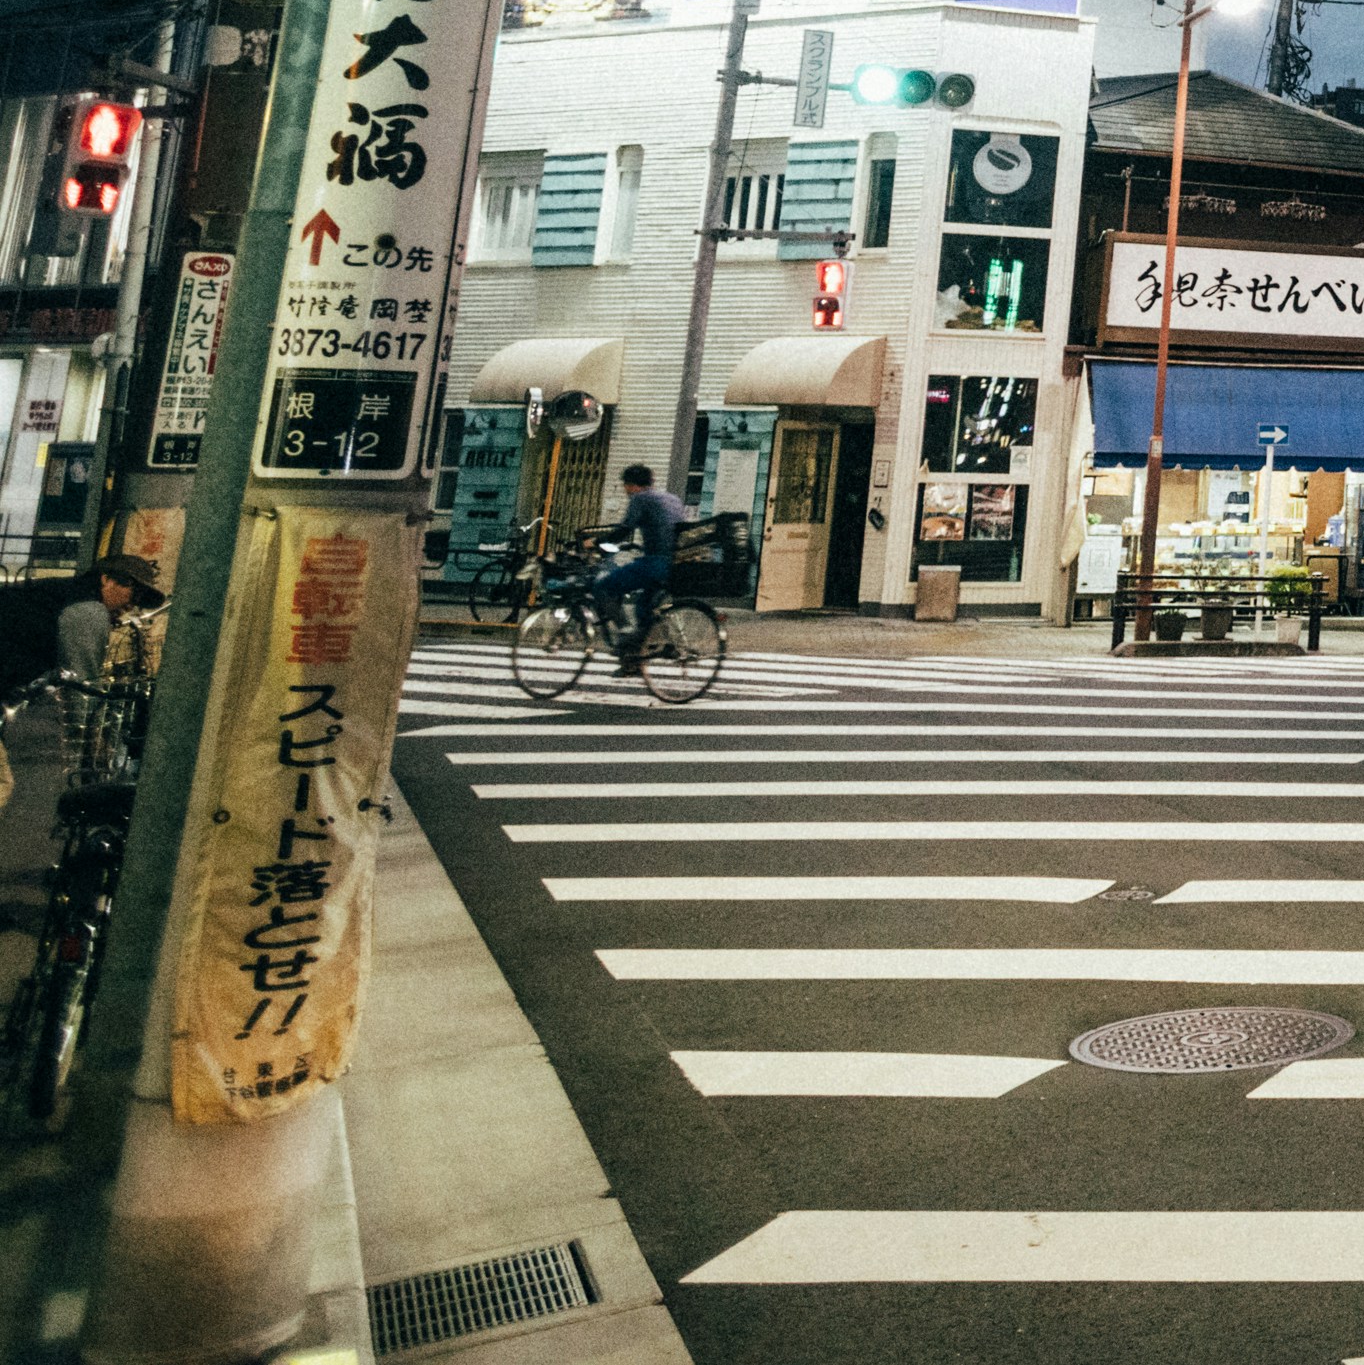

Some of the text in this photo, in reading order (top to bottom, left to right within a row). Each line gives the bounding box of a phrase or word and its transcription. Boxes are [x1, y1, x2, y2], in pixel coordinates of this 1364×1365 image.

[801, 33, 826, 125] スクランブル式
[343, 243, 433, 273] この先
[183, 279, 220, 375] さんえい
[278, 328, 427, 361] 3873-4617
[286, 392, 392, 421] 根岸
[163, 451, 194, 462] 3-12
[284, 431, 381, 458] 3-12
[284, 534, 369, 666] 自転車
